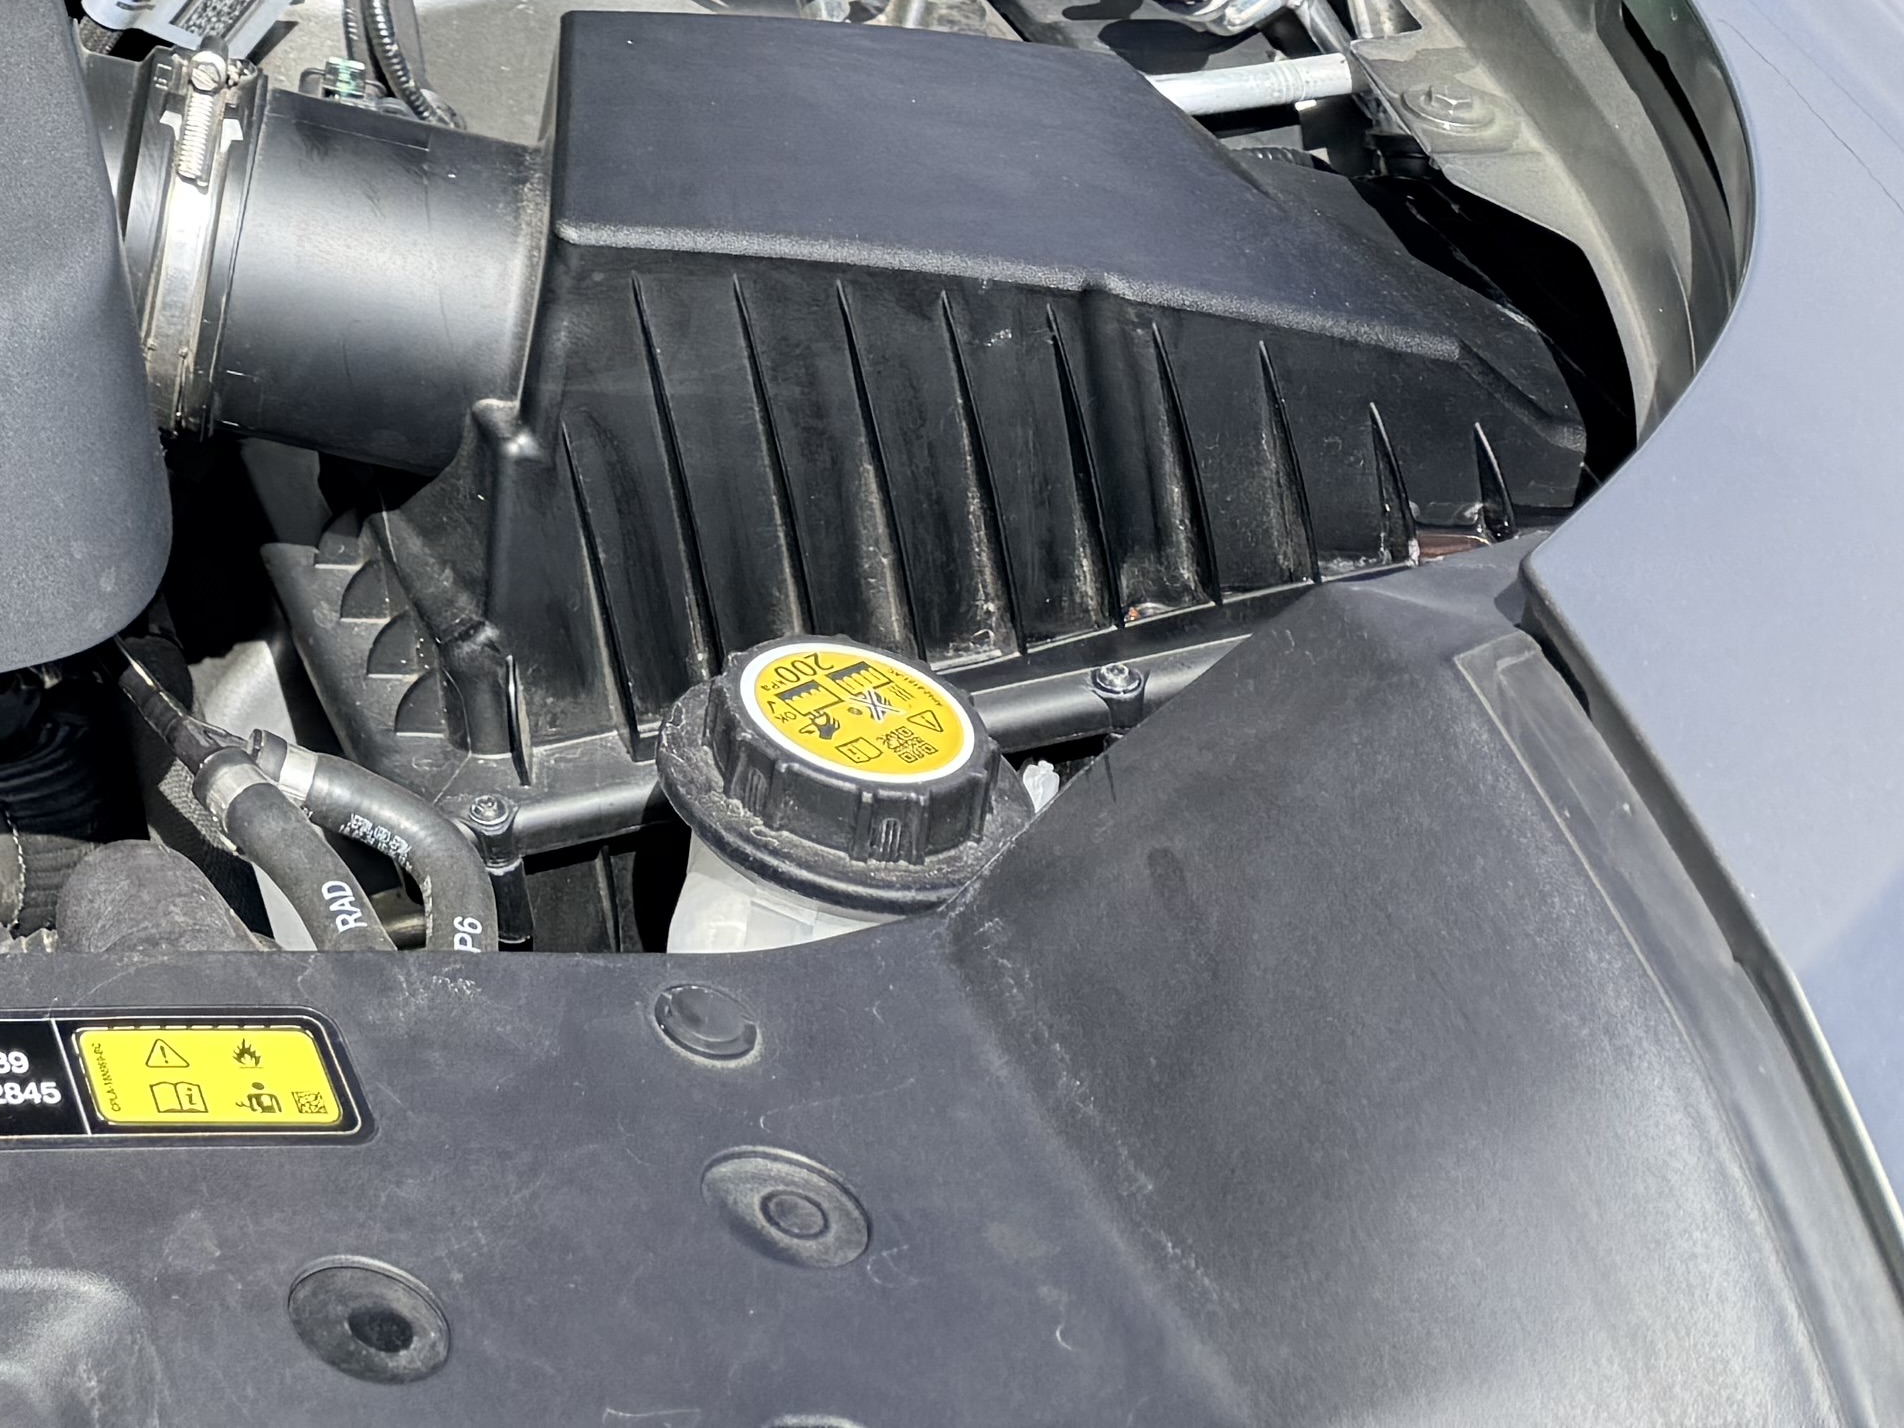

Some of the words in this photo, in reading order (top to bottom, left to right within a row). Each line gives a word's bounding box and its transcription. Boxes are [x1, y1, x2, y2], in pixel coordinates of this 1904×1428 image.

[774, 652, 835, 683] 200
[760, 679, 788, 692] kPa
[774, 711, 797, 724] OK
[321, 879, 368, 932] RAD
